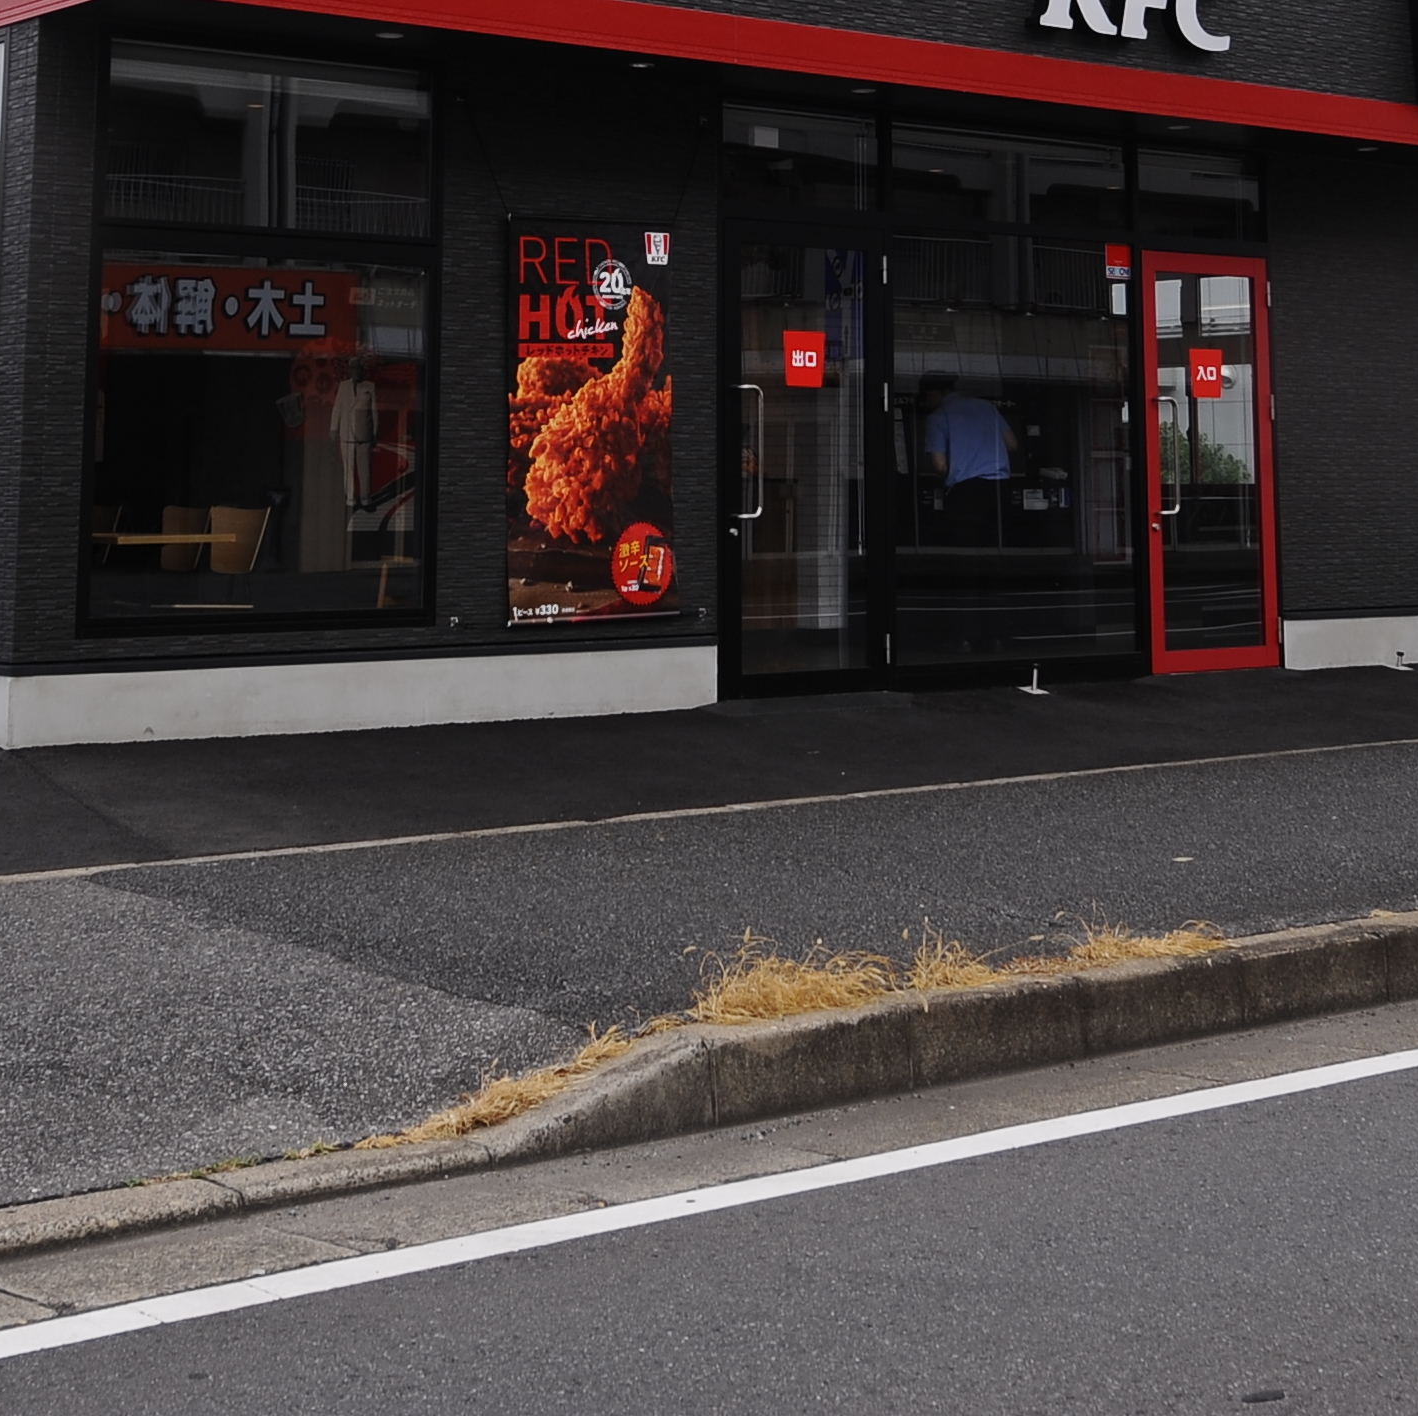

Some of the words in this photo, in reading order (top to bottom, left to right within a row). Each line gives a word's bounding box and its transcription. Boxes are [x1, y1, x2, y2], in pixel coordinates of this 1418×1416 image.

[518, 235, 613, 286] RED
[518, 285, 614, 341] HOT
[566, 318, 619, 340] chicken
[791, 349, 818, 368] 出口
[1195, 364, 1218, 383] 入口
[619, 554, 649, 573] ソース
